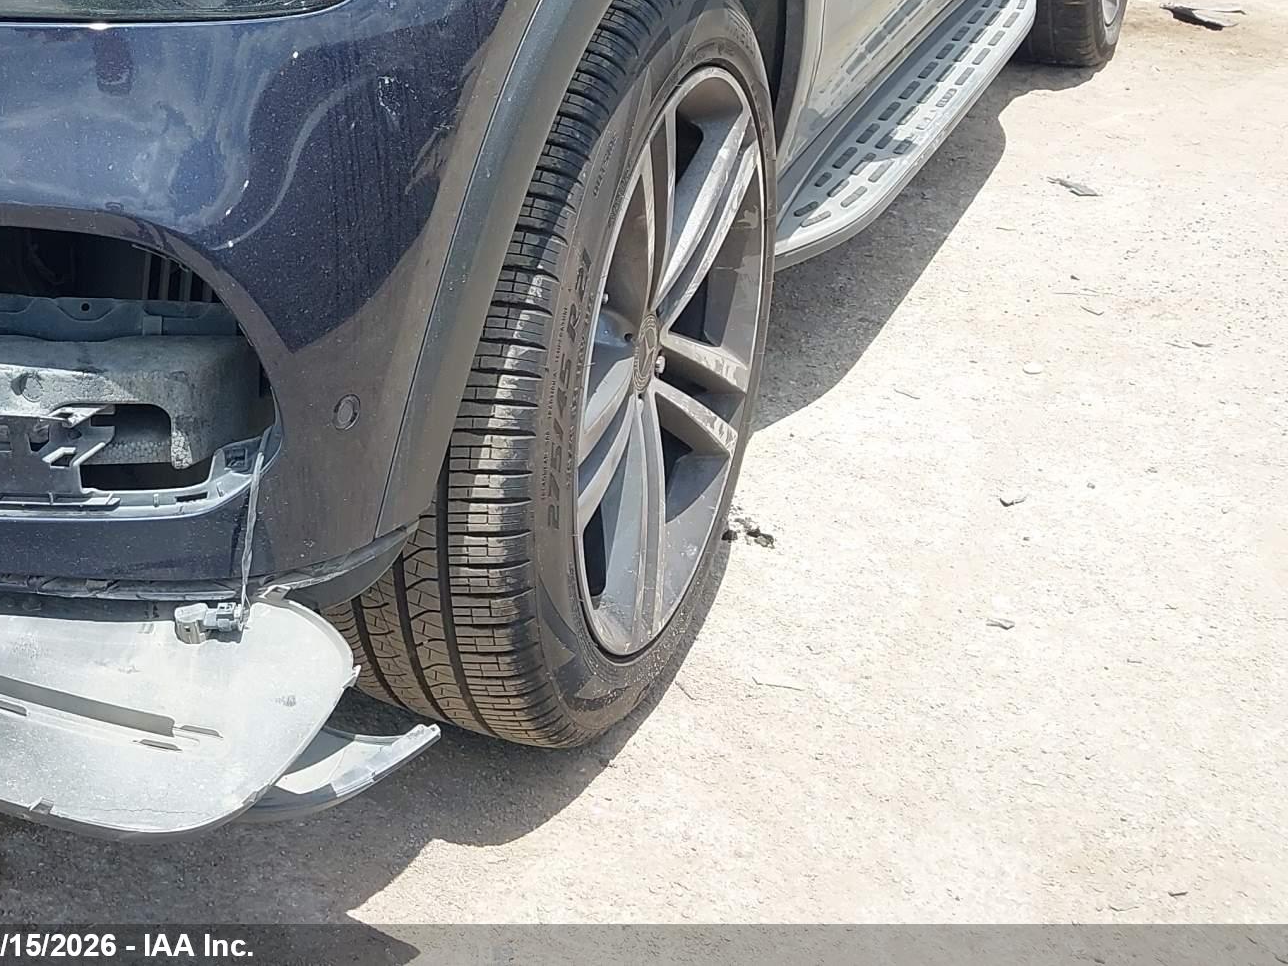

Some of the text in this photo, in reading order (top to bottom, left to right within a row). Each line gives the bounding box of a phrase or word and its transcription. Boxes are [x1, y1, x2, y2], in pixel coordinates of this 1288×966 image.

[547, 353, 573, 531] 275/45
[566, 303, 581, 343] R
[574, 247, 592, 303] 21
